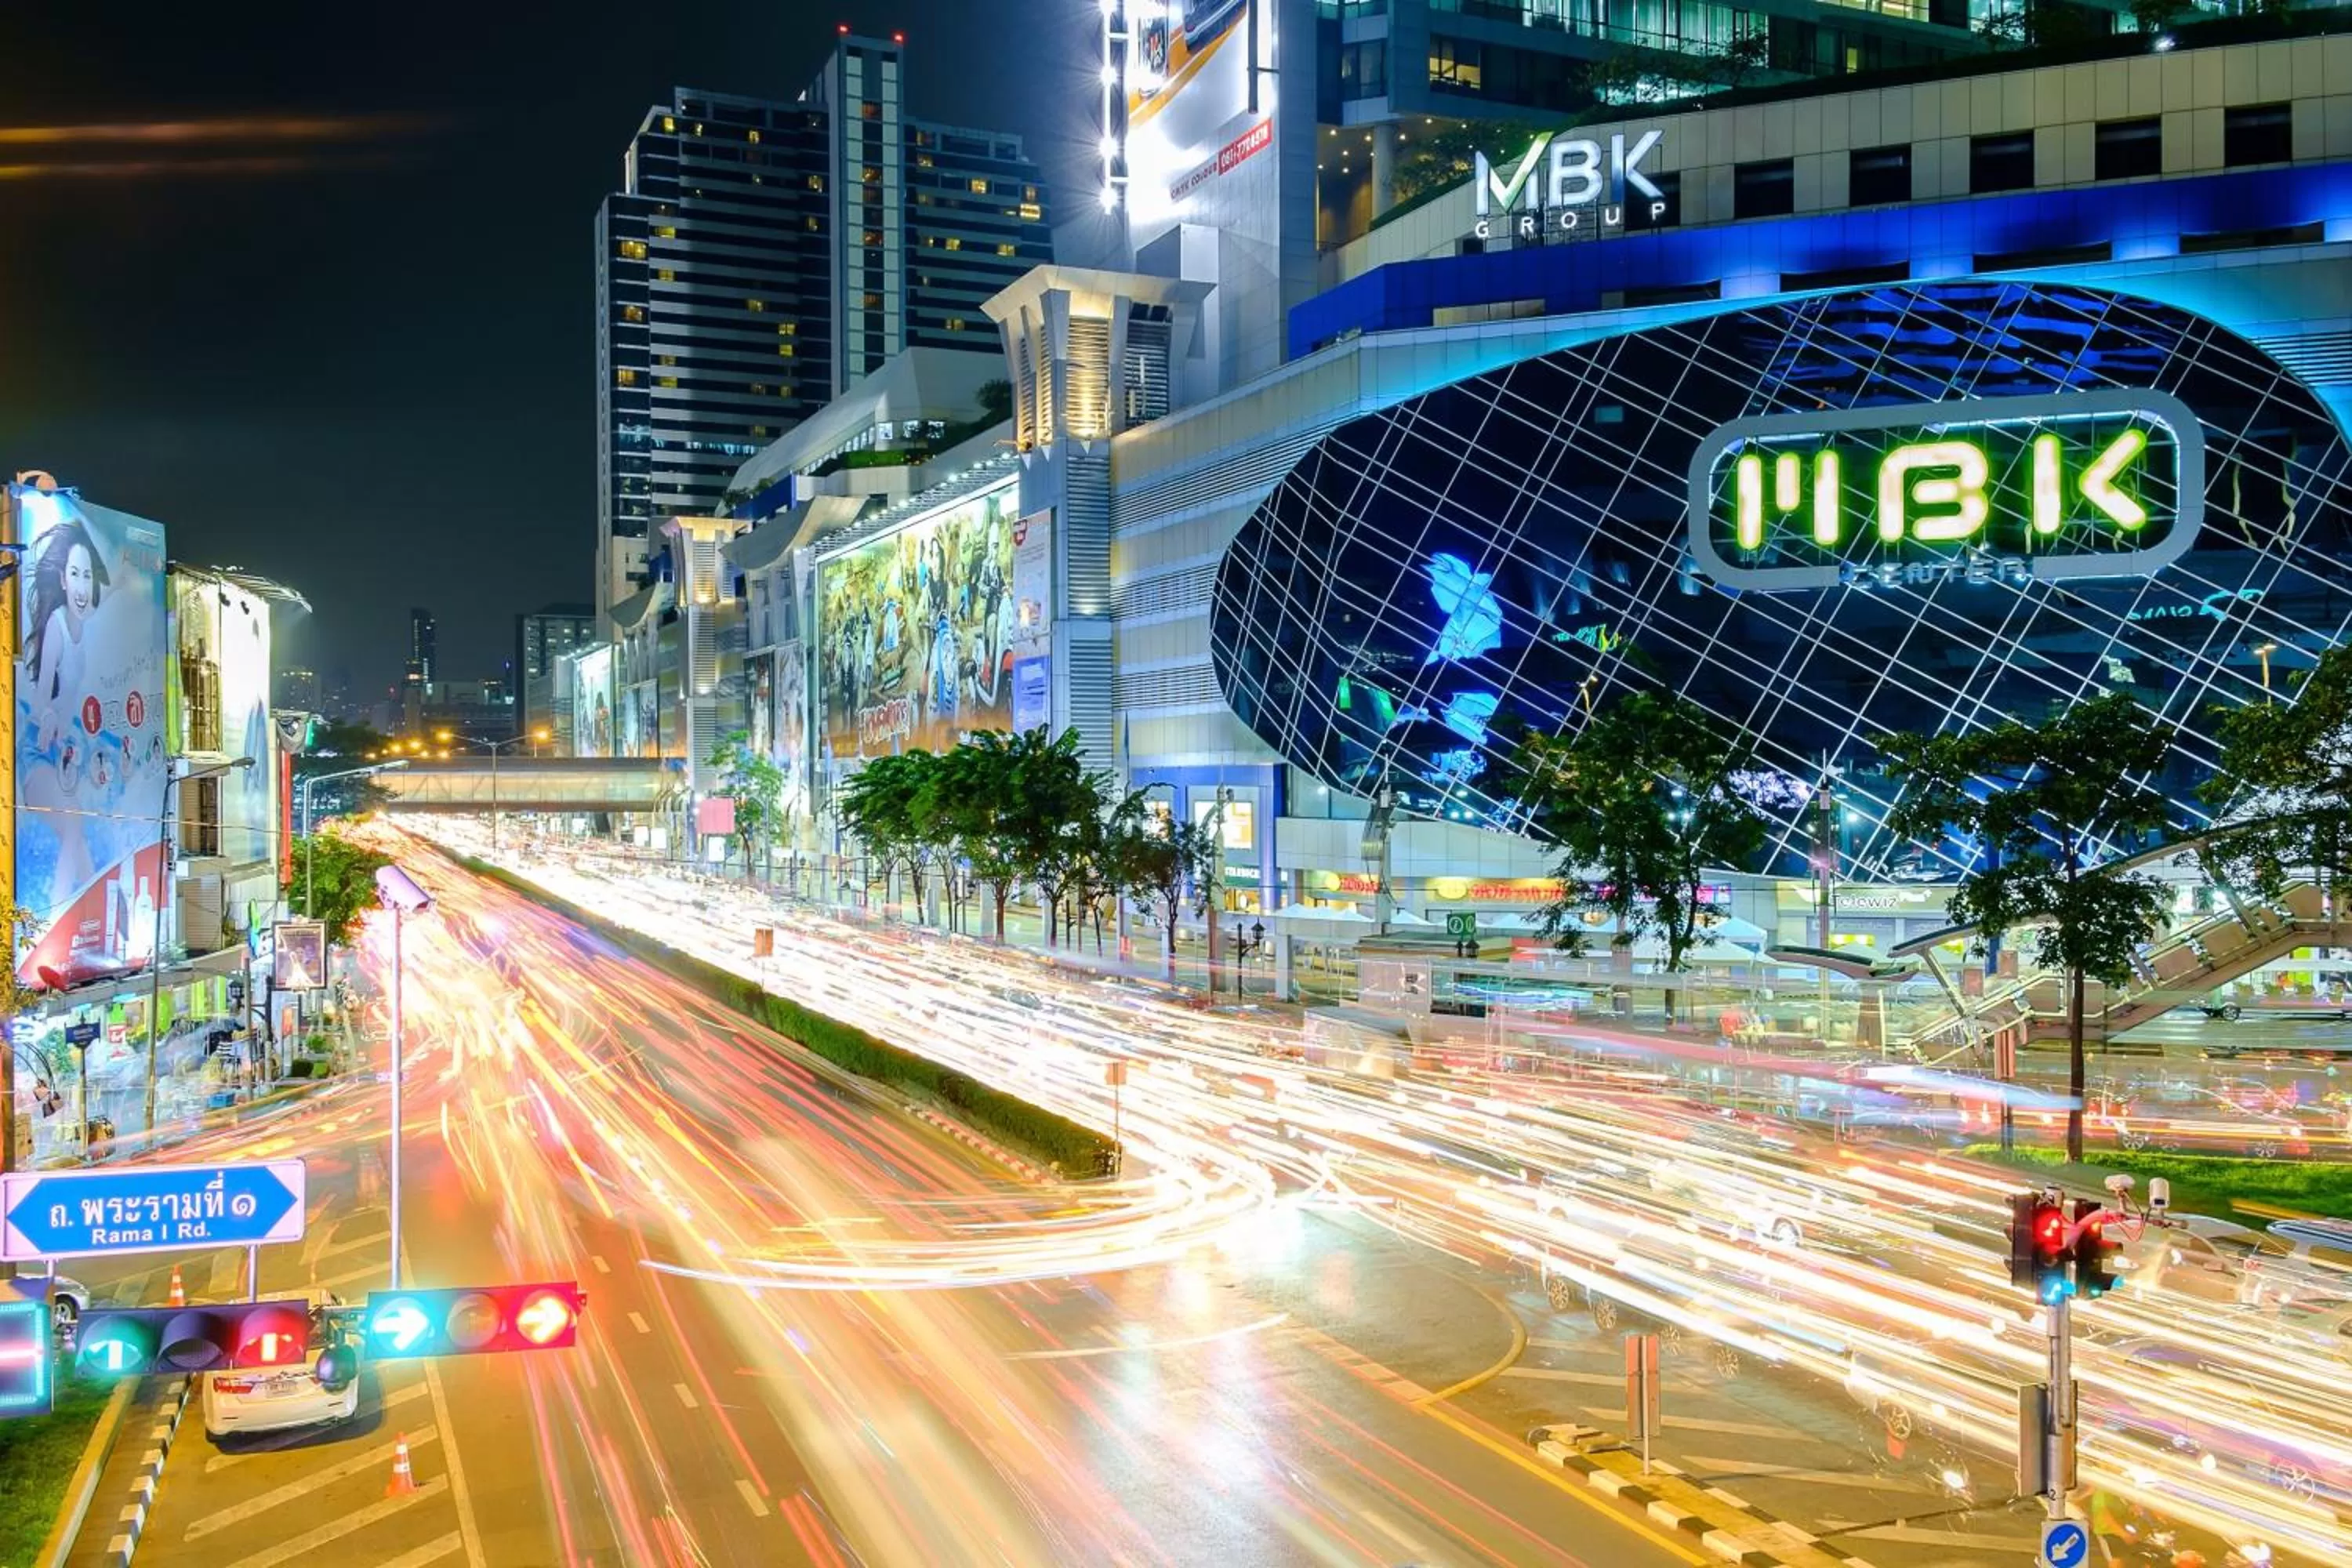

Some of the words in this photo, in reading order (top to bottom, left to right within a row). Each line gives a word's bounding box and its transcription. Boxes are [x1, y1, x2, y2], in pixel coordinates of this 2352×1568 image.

[1475, 130, 1665, 213] MBK
[1475, 201, 1666, 238] GROUP
[1736, 428, 2147, 550] MBK
[1850, 557, 2027, 590] CENTER
[50, 1204, 74, 1228] ถ.
[82, 1170, 224, 1225] พระรามที่
[91, 1228, 153, 1245] Rama
[178, 1221, 211, 1240] Rd.
